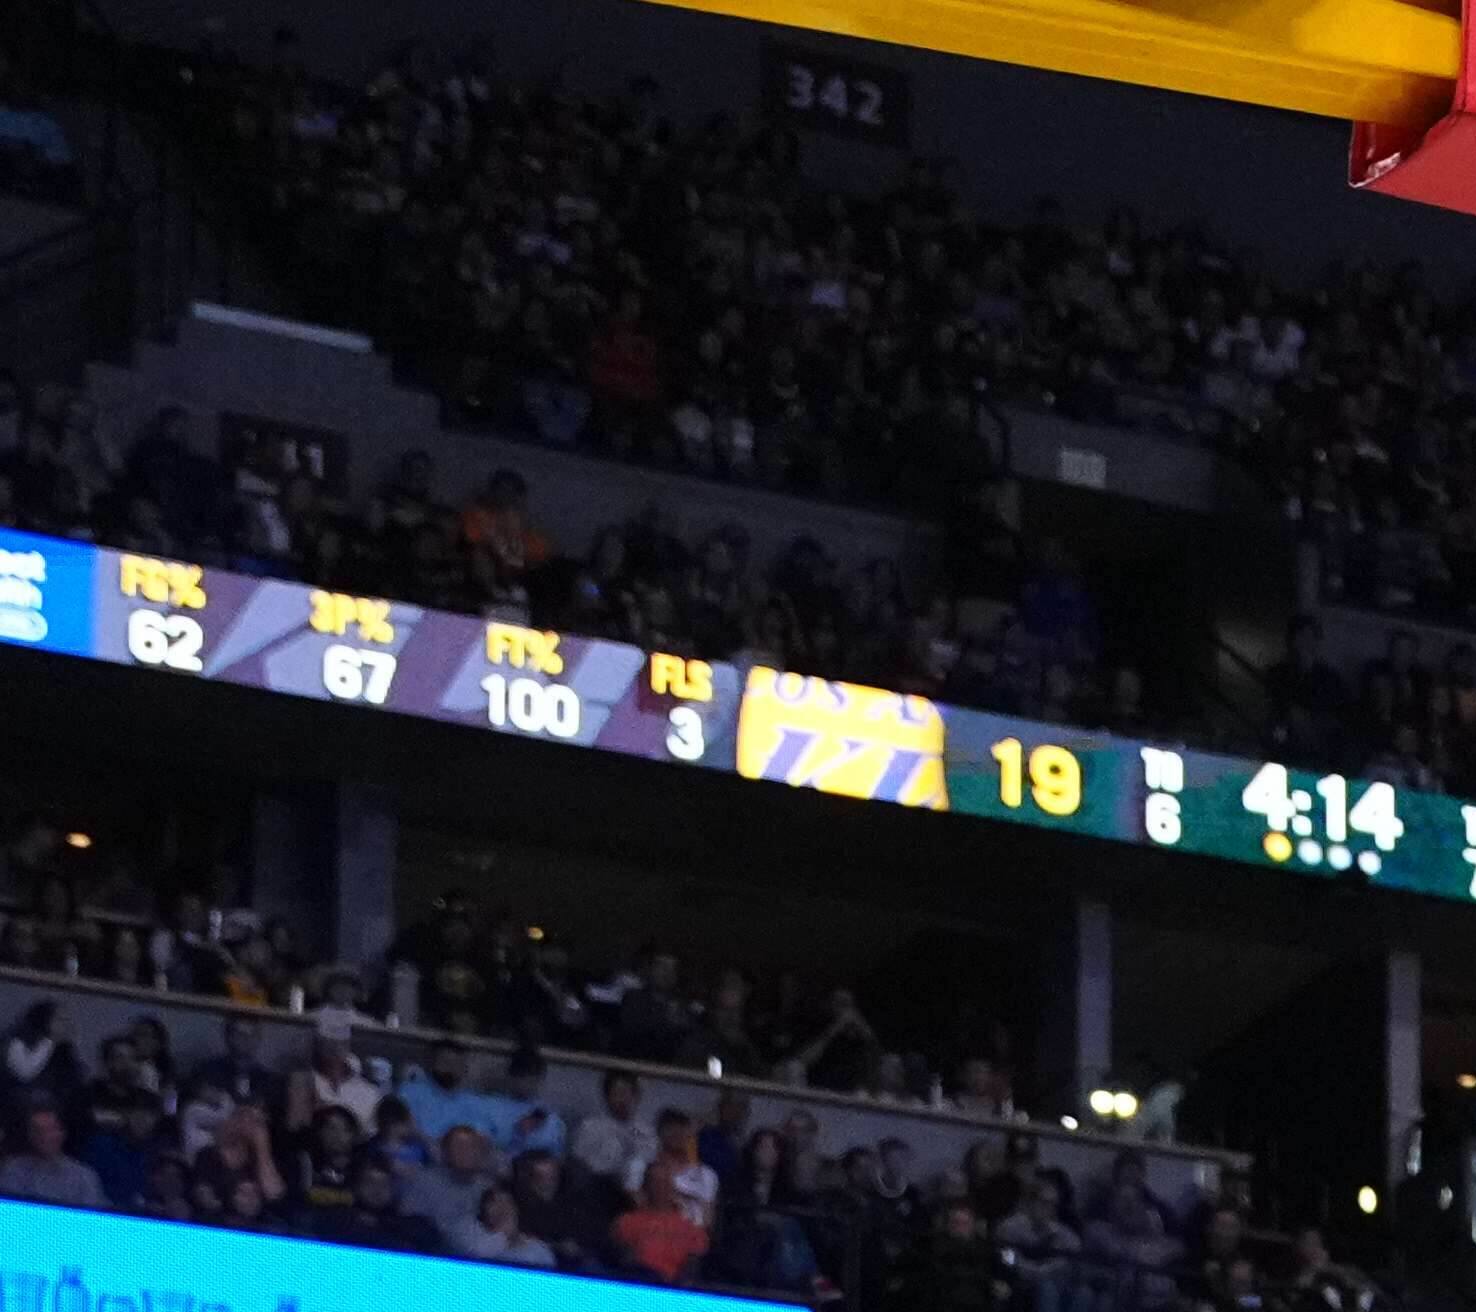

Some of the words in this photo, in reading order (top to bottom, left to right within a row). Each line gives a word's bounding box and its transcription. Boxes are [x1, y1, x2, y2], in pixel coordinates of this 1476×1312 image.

[783, 62, 885, 126] 342
[127, 608, 204, 672] 62
[308, 589, 394, 645] 3P%
[322, 643, 397, 704] 67
[485, 621, 564, 676] FT%
[650, 650, 713, 702] FLS
[480, 672, 581, 739] 100
[666, 706, 705, 761] 3
[991, 736, 1082, 817] 19
[1241, 761, 1405, 852] 4:14
[1144, 791, 1182, 846] 6
